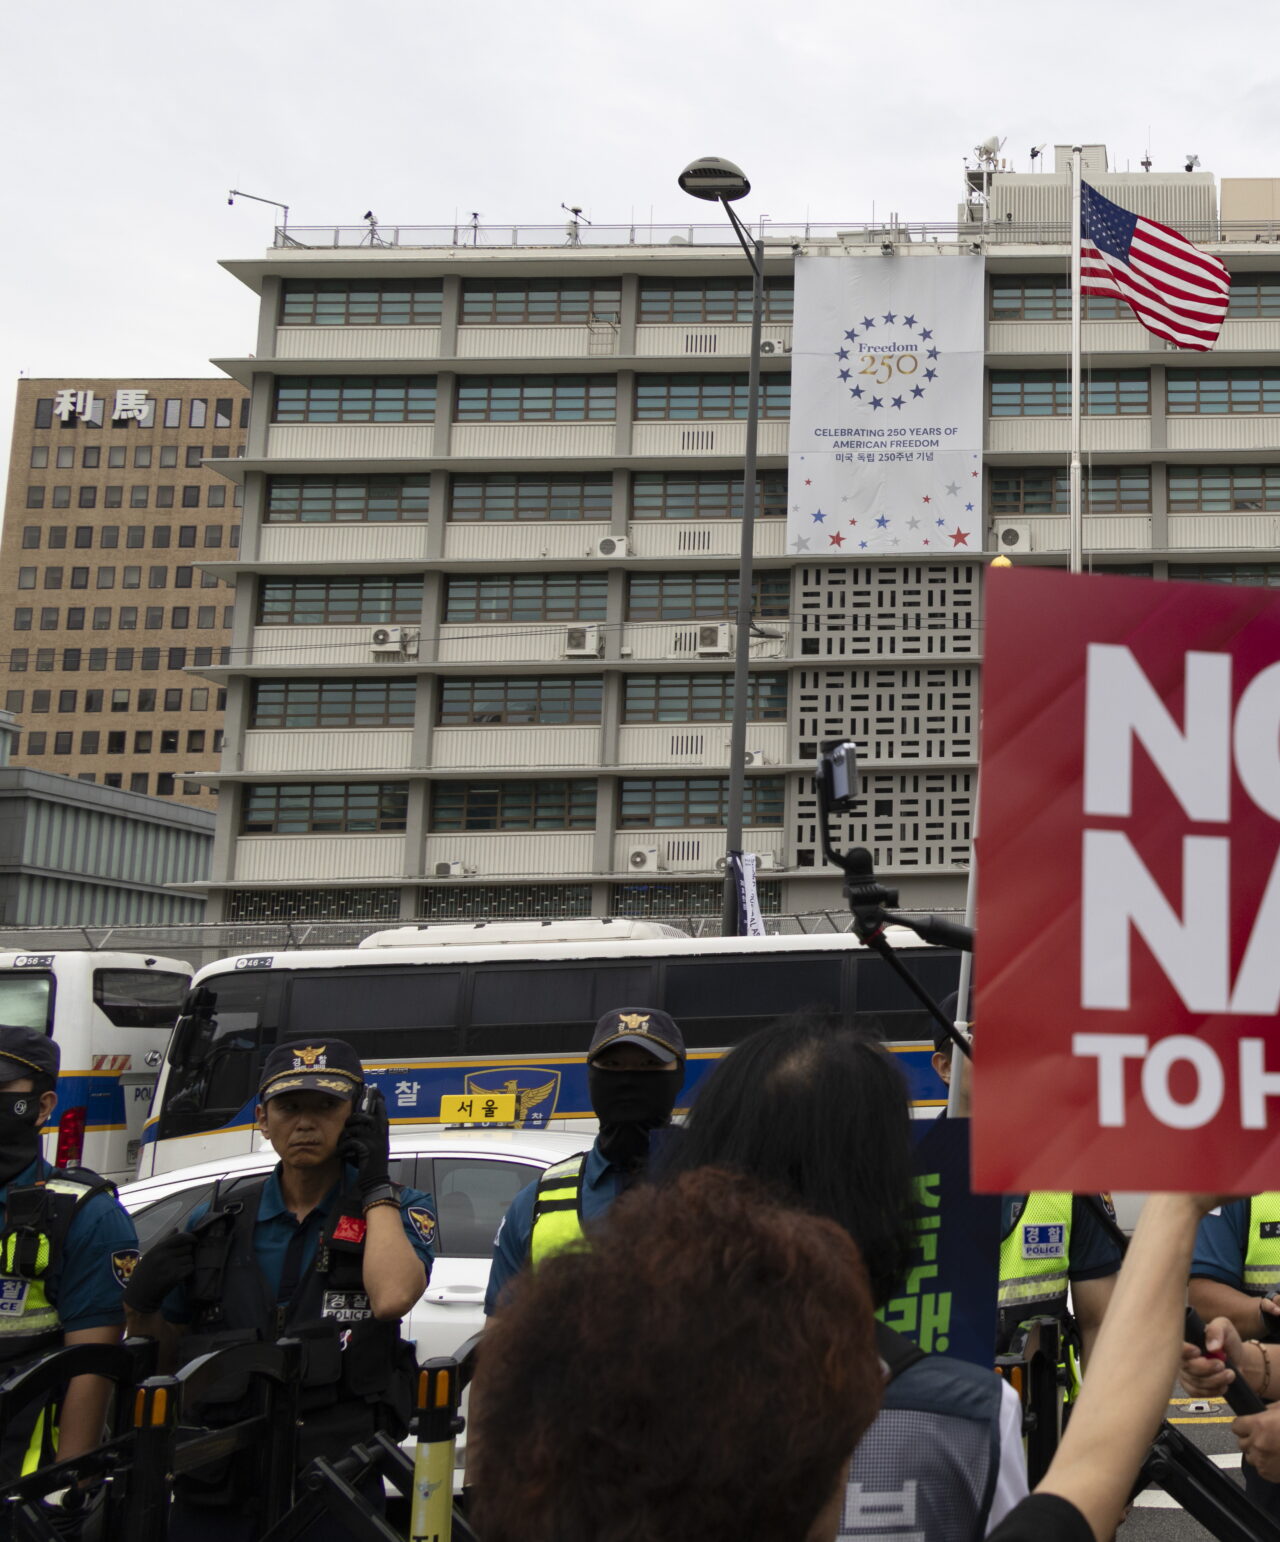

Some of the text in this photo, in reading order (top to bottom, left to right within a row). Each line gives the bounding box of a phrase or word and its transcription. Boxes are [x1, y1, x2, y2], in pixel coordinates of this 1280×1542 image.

[858, 342, 918, 352] Freedom
[858, 354, 918, 384] 250
[814, 427, 958, 437] CELEBRATING 250 YEARS OF
[832, 439, 939, 449] AMERICAN FREEDOM
[835, 452, 934, 462] 미국 독립 250주년 기념
[1072, 1033, 1224, 1129] TO
[1026, 1246, 1061, 1254] POLICE
[326, 1310, 369, 1320] POLICE
